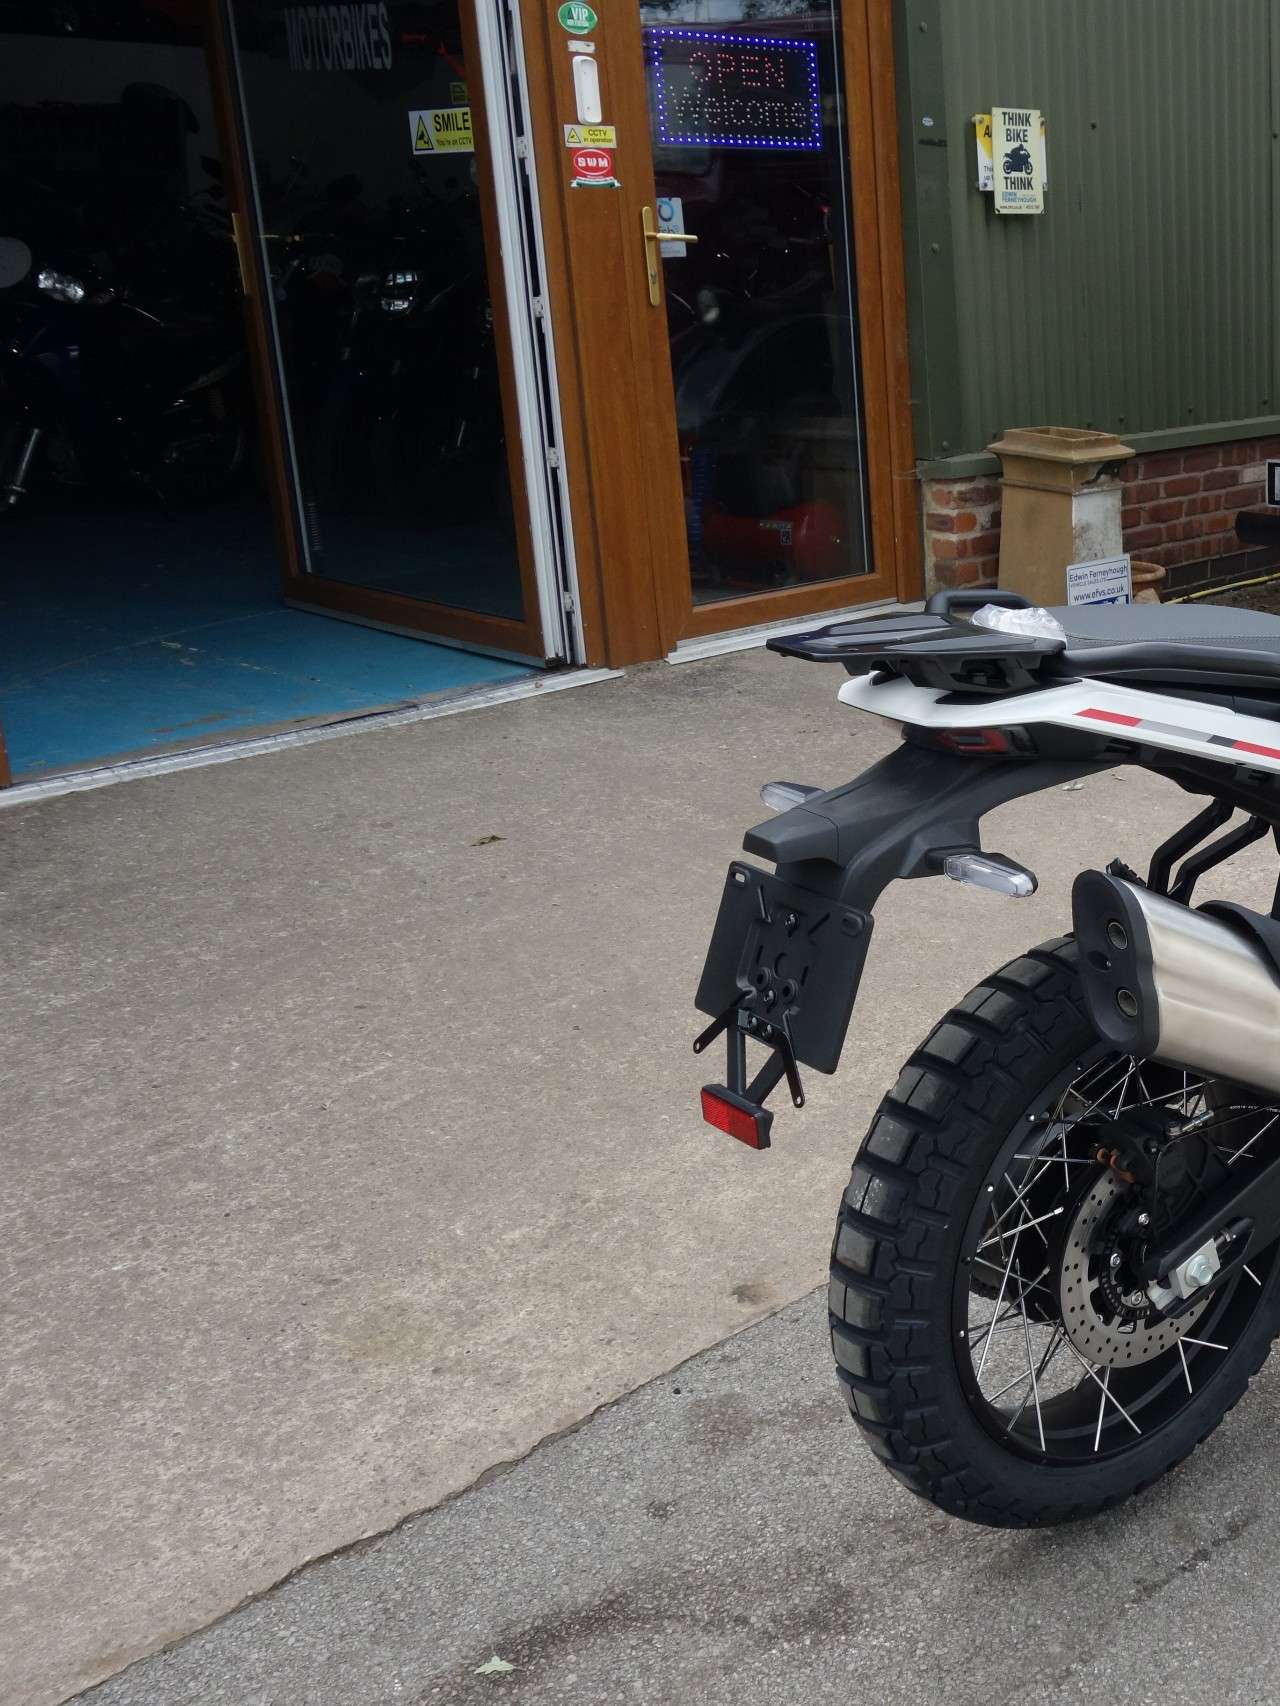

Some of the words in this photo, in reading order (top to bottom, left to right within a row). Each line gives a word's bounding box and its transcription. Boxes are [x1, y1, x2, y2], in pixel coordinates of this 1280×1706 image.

[283, 2, 393, 70] MOTORBIKES
[688, 51, 786, 88] OPEN
[670, 86, 807, 128] Welcome
[433, 111, 471, 132] SMILE
[1002, 111, 1032, 127] THINK
[587, 128, 608, 137] CCTV
[1006, 128, 1029, 142] BIKE
[577, 157, 609, 168] SWM
[1003, 176, 1034, 191] THINK
[1069, 573, 1089, 582] Edwin
[1089, 564, 1128, 578] Ferneyhough
[1073, 584, 1124, 602] www.efvs.co.uk
